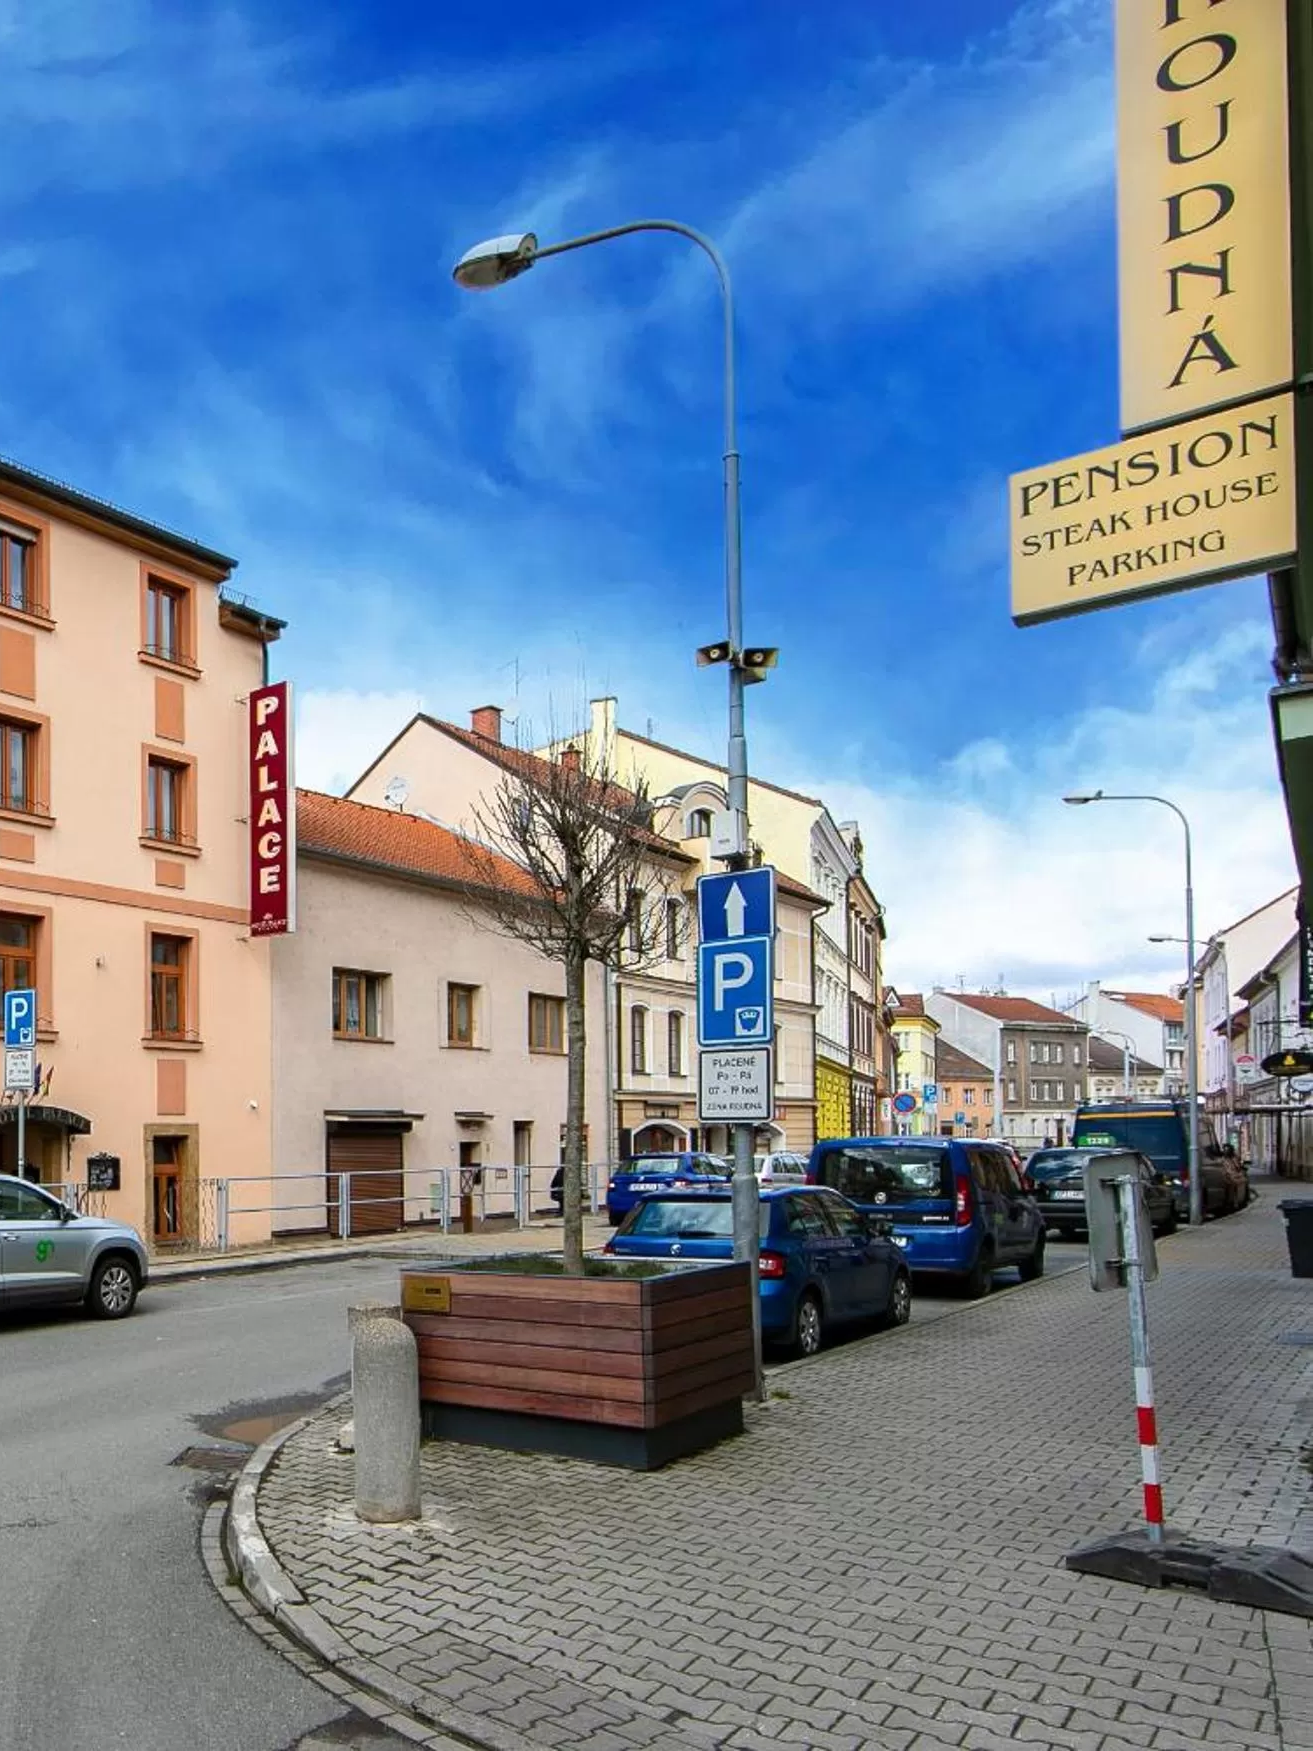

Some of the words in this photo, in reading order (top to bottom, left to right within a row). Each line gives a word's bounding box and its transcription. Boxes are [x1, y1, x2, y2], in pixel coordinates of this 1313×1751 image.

[1019, 414, 1278, 518] PENSION
[1021, 510, 1133, 556] STEAK
[1144, 471, 1280, 526] HOUSE
[1068, 529, 1226, 587] PARKING
[254, 695, 283, 895] PALACE
[11, 997, 28, 1029] P
[714, 952, 754, 1012] P
